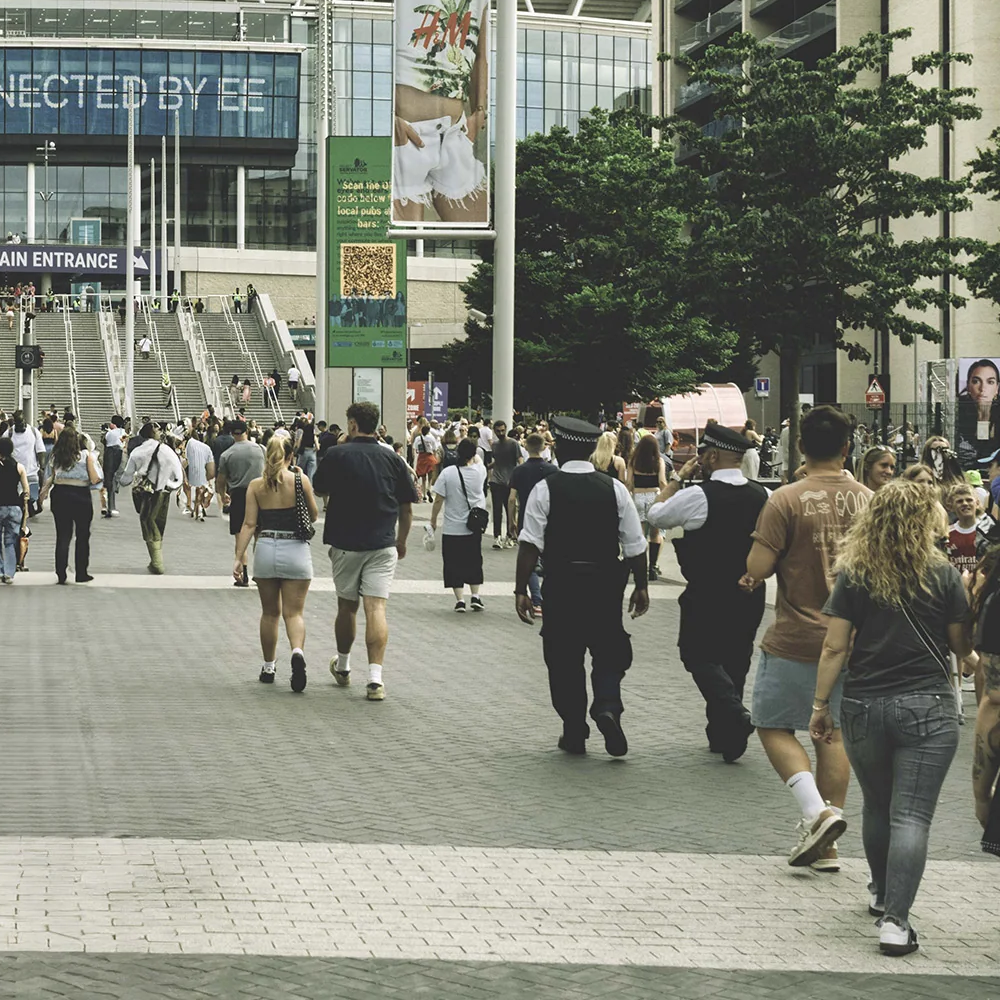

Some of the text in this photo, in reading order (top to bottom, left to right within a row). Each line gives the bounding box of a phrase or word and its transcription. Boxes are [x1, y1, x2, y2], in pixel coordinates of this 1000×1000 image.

[413, 10, 472, 50] H&M
[158, 75, 208, 111] BY
[217, 76, 266, 113] EE
[342, 180, 364, 190] Scan
[337, 193, 358, 203] code
[360, 193, 386, 203] below
[337, 206, 359, 216] local
[361, 206, 382, 217] pubs
[357, 218, 380, 228] bars:
[32, 252, 118, 269] ENTRANCE
